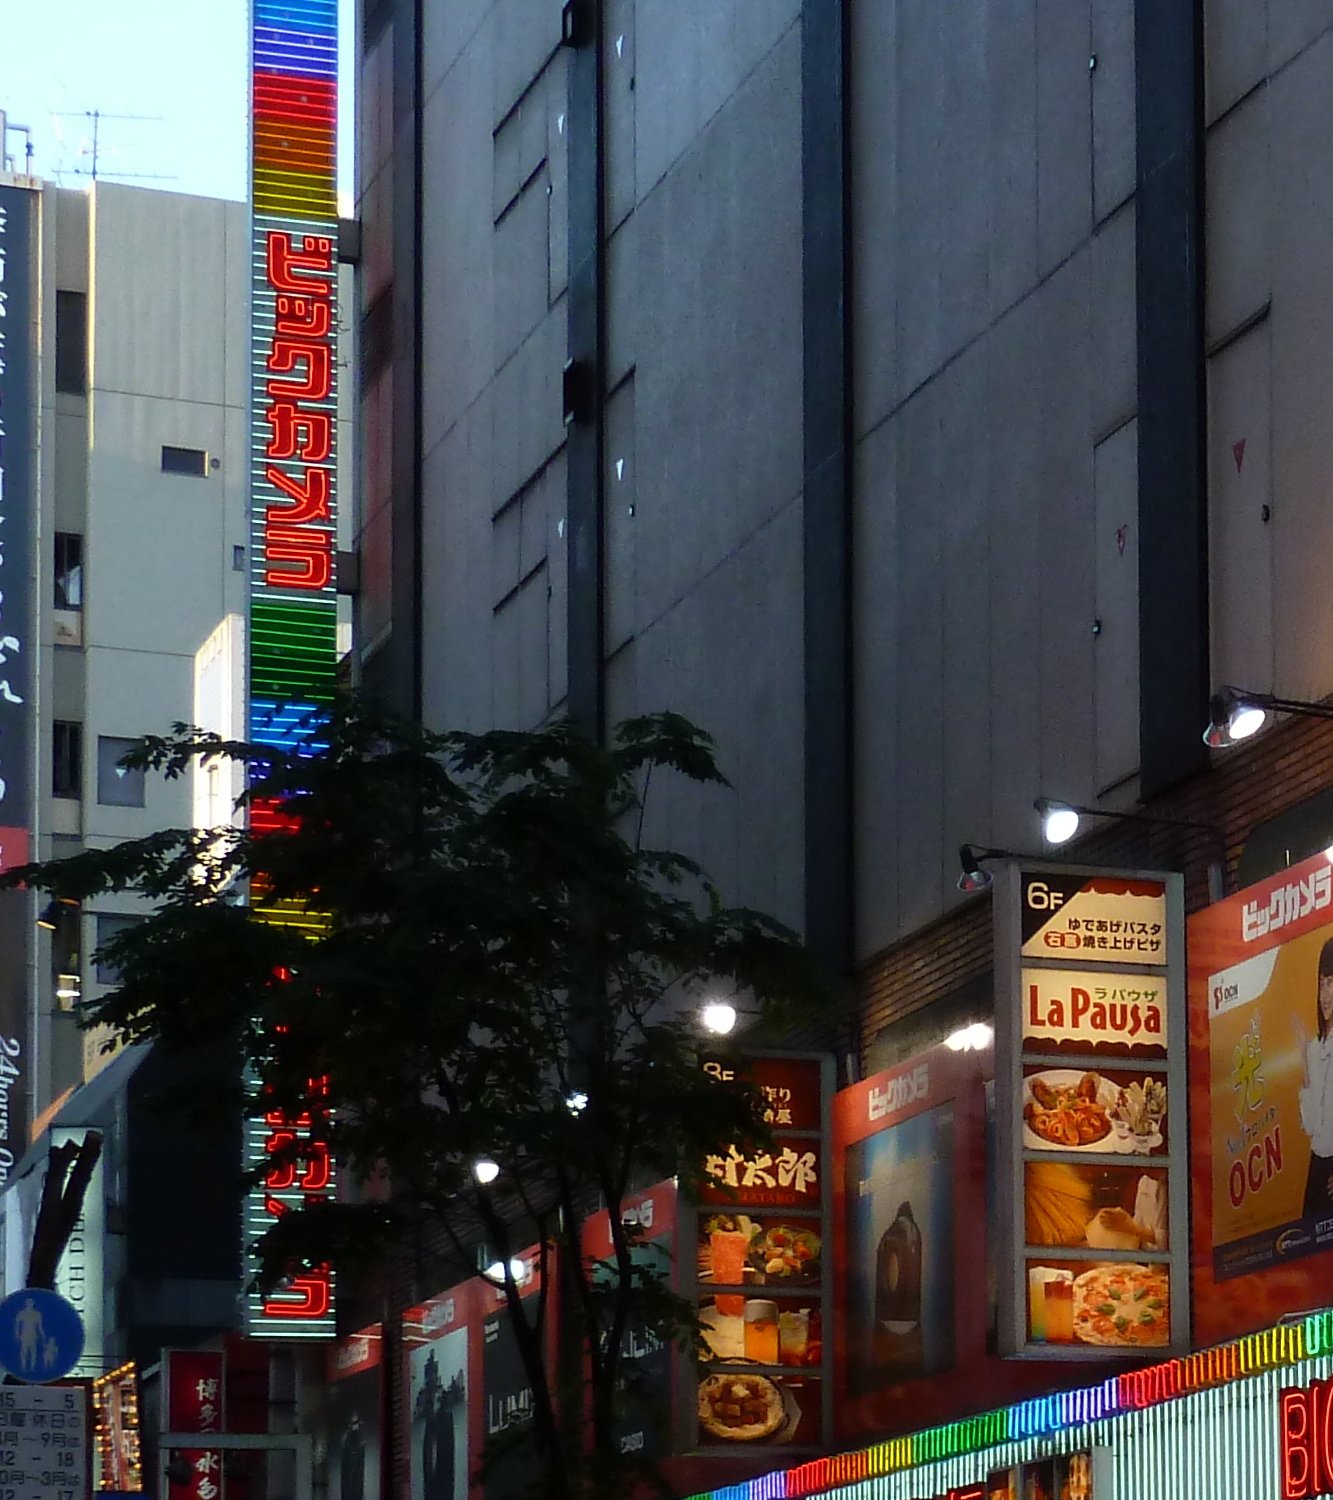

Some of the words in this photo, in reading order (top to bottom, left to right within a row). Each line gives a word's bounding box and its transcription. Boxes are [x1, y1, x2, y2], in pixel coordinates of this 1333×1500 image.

[265, 230, 333, 592] ビックカメラ
[1027, 882, 1063, 911] 6F
[1242, 865, 1332, 942] ビックカメラ
[1029, 984, 1064, 1028] La
[1070, 987, 1161, 1037] Pausa
[1094, 988, 1159, 1002] ラパウザ
[1228, 1124, 1284, 1209] OCN
